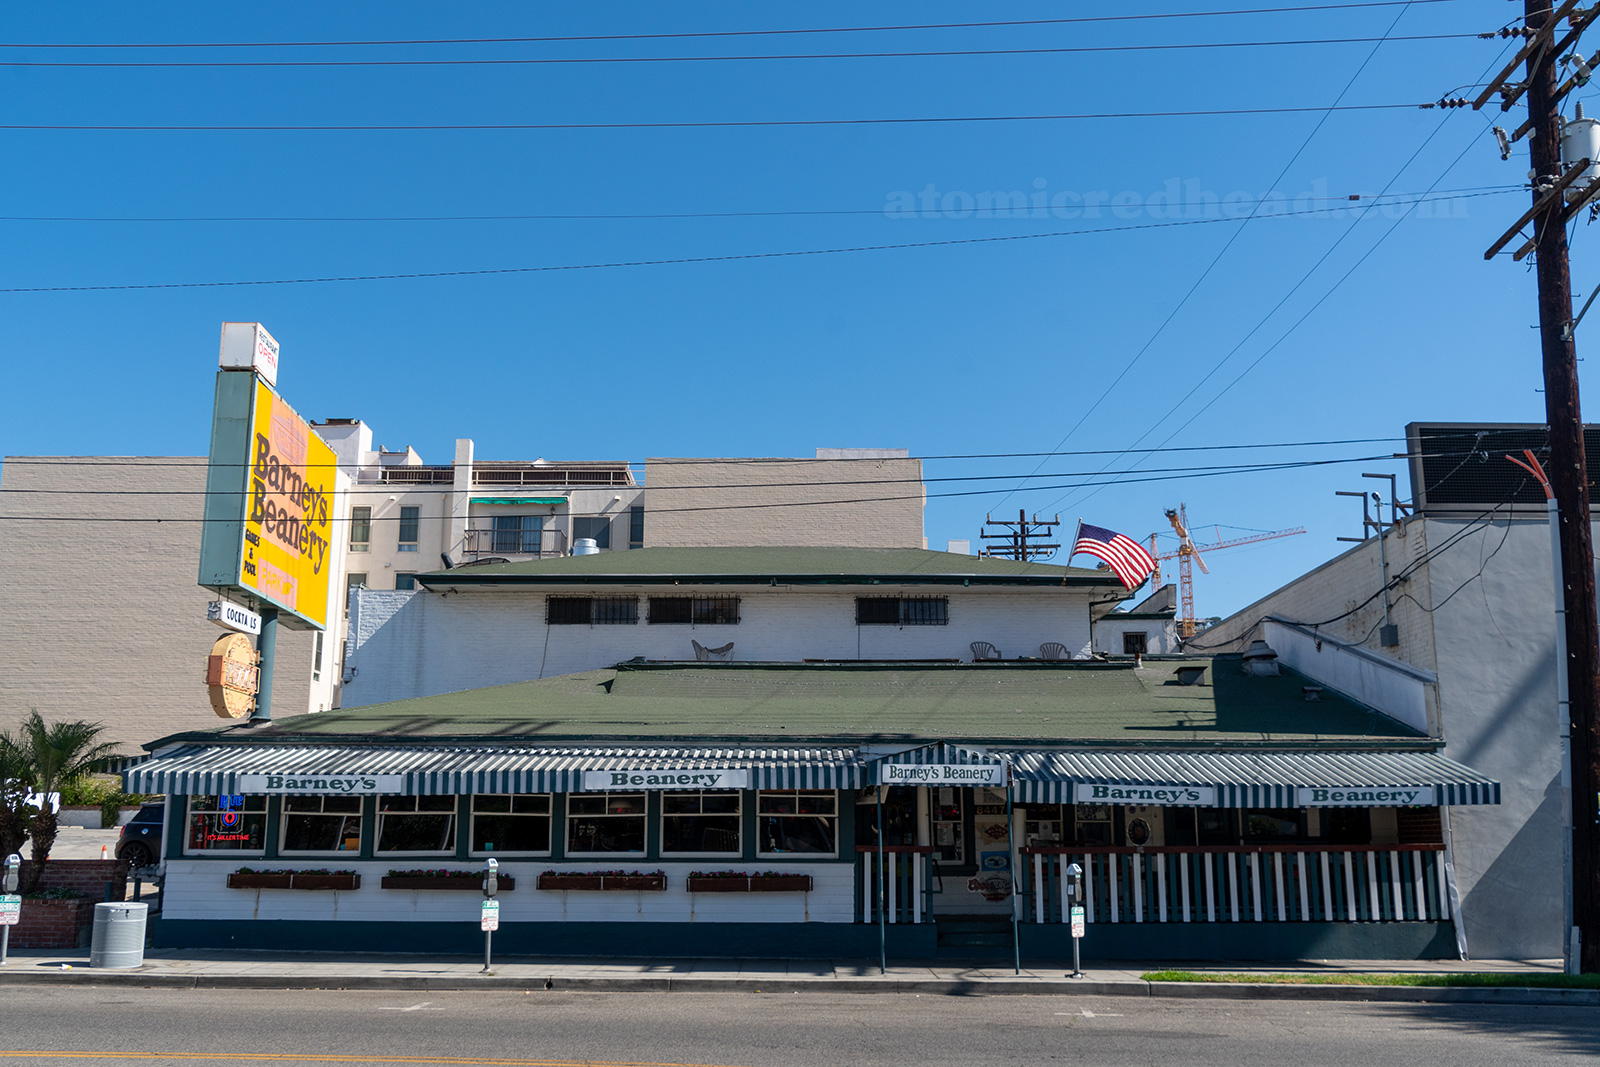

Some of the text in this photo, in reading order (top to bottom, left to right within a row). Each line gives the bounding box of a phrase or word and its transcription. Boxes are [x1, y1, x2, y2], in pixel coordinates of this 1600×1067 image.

[258, 342, 277, 369] OPEN
[254, 432, 328, 527] Barney's
[251, 477, 328, 575] Beanery
[243, 560, 257, 576] POOL
[261, 567, 281, 594] PARK
[610, 772, 722, 788] Beanery
[889, 765, 995, 781] Barney's Beanery
[266, 776, 376, 792] Barney's
[1091, 785, 1201, 803] Barney's
[1311, 788, 1420, 804] Beanery
[976, 806, 1005, 815] 8447
